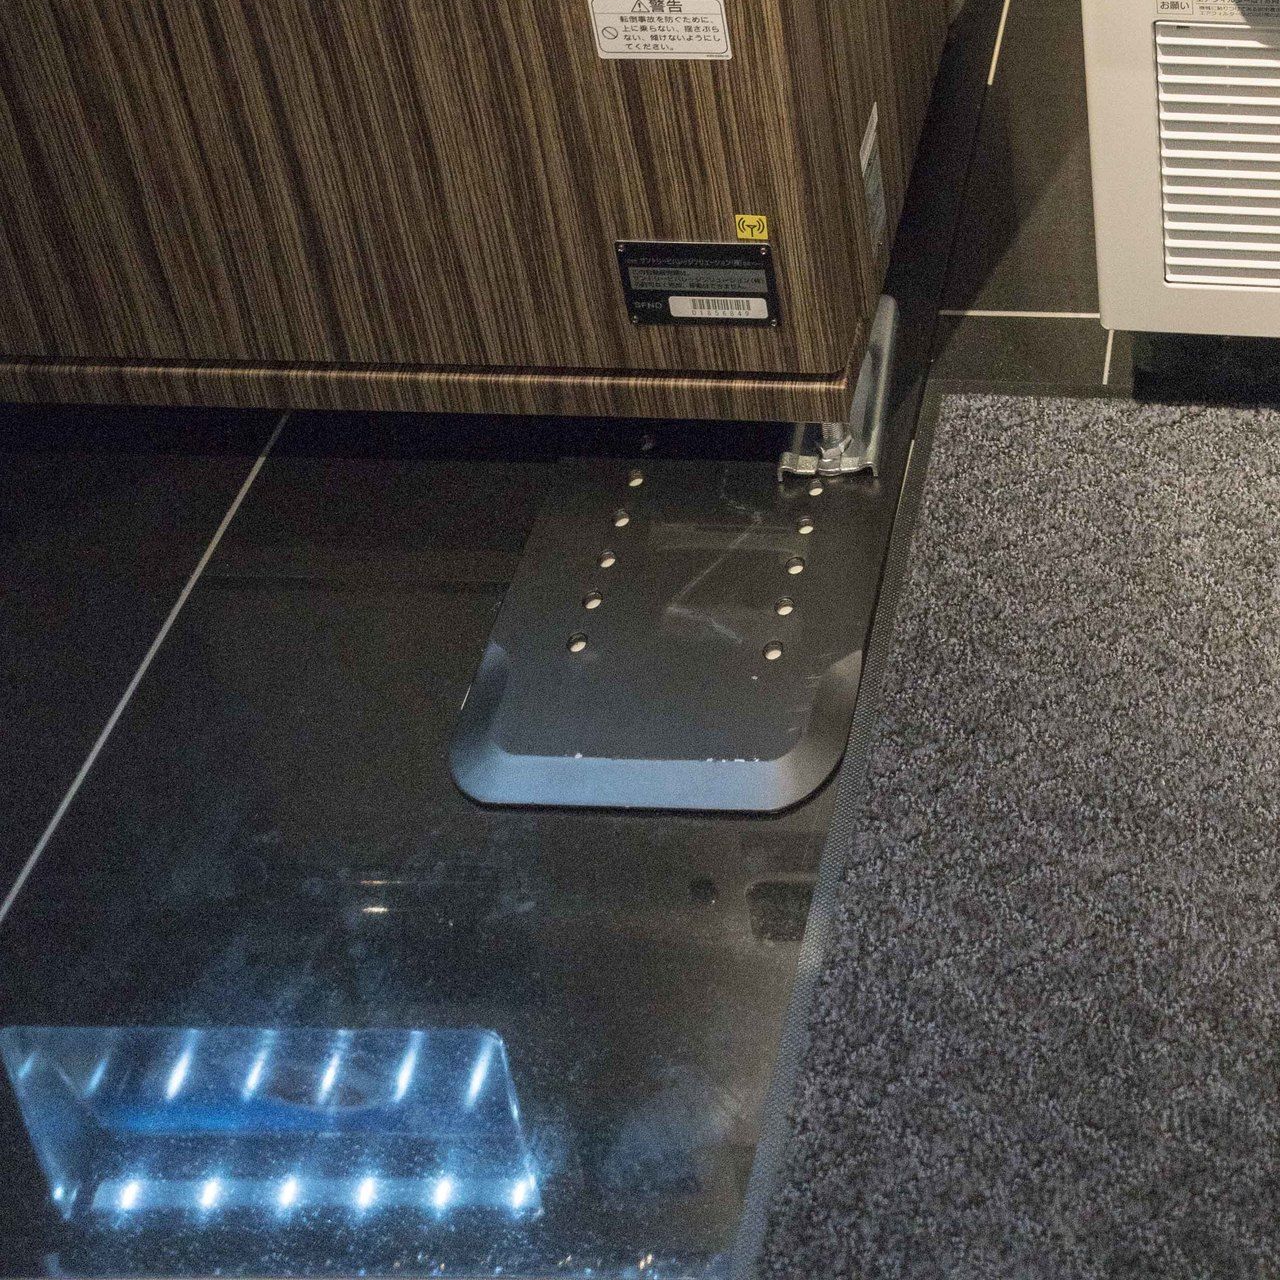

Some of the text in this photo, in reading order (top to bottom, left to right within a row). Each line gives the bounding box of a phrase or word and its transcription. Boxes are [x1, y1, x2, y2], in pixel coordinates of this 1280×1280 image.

[649, 0, 683, 13] 警告
[1160, 1, 1190, 10] お願い
[626, 43, 674, 51] てください。
